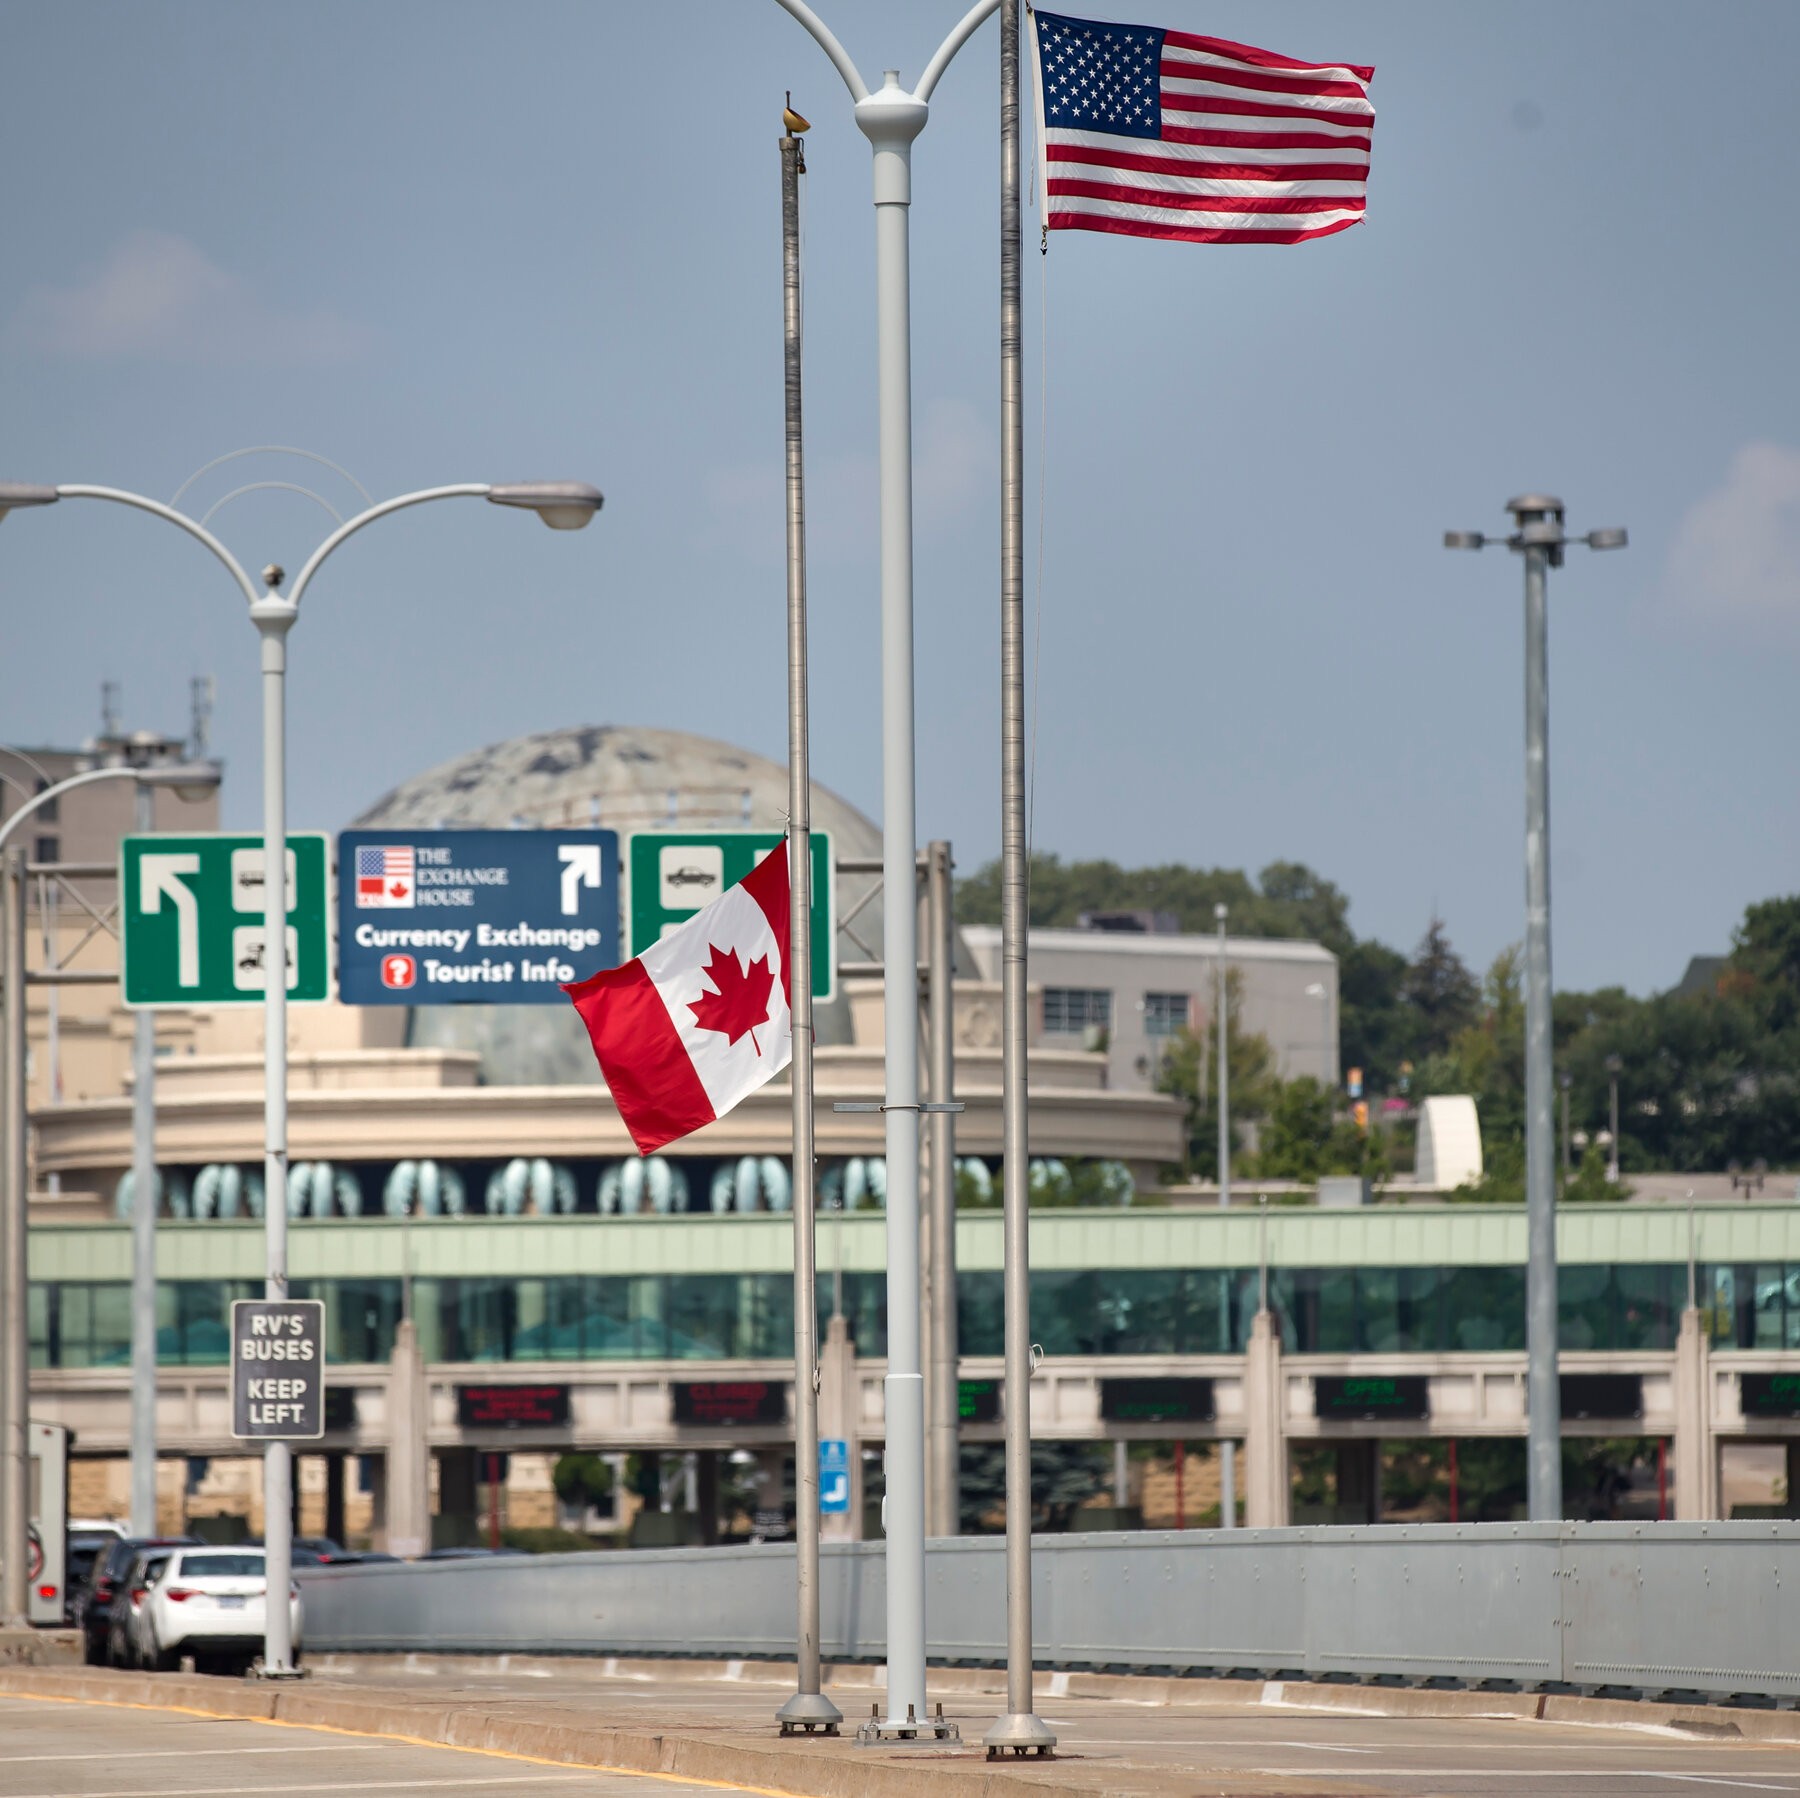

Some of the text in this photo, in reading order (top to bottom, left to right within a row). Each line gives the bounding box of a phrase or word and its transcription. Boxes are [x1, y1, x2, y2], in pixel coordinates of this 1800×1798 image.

[416, 847, 452, 865] THE
[416, 867, 509, 886] EXCHANGE
[416, 888, 475, 906] HOUSE
[355, 921, 601, 952] Currency Exchange
[423, 958, 515, 982] Tourist
[521, 956, 575, 982] Info
[251, 1314, 304, 1336] RV'S
[241, 1338, 314, 1361] BUSES
[247, 1378, 307, 1399] KEEP
[1344, 1379, 1395, 1396] OPEN
[249, 1403, 305, 1424] LEFT
